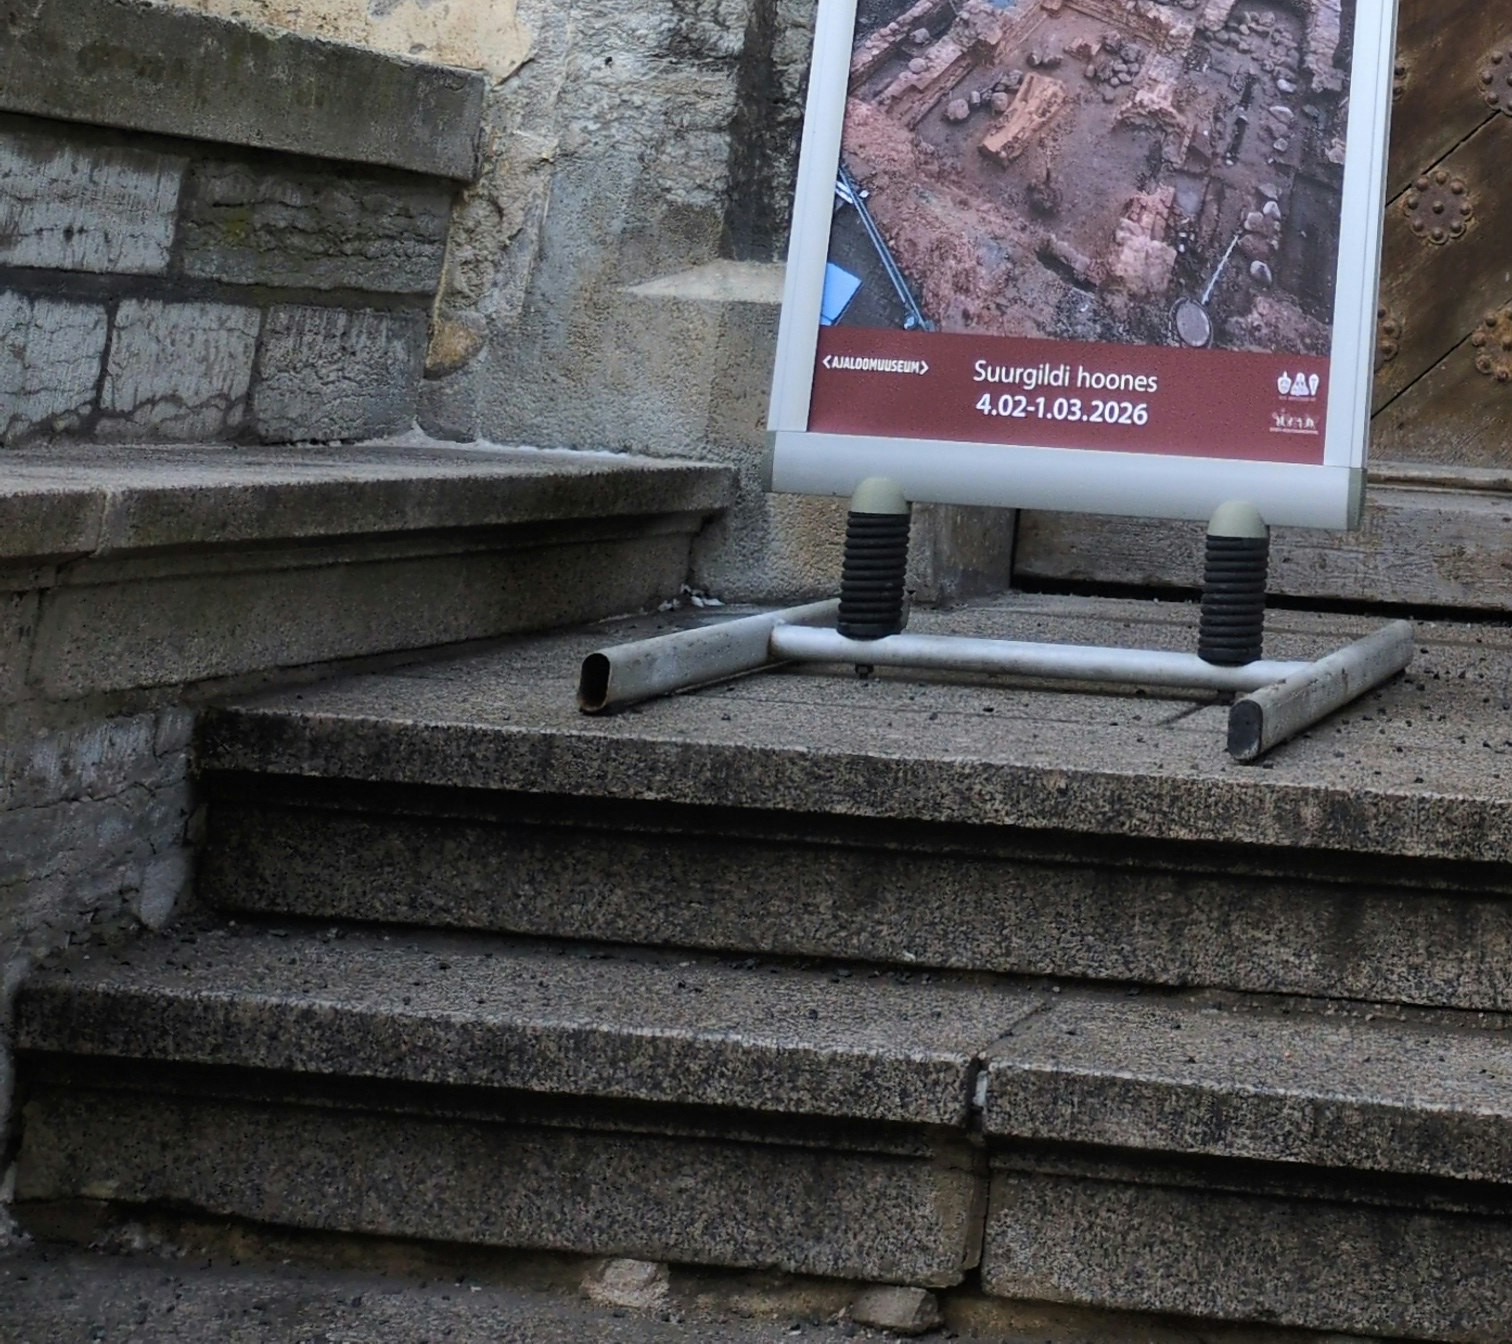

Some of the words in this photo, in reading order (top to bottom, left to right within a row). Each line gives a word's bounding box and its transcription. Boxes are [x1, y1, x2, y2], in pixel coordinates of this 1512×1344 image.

[972, 360, 1070, 391] Suurgildi
[1077, 365, 1158, 393] hoones
[975, 393, 1148, 426] 4.02-1.03.2026
